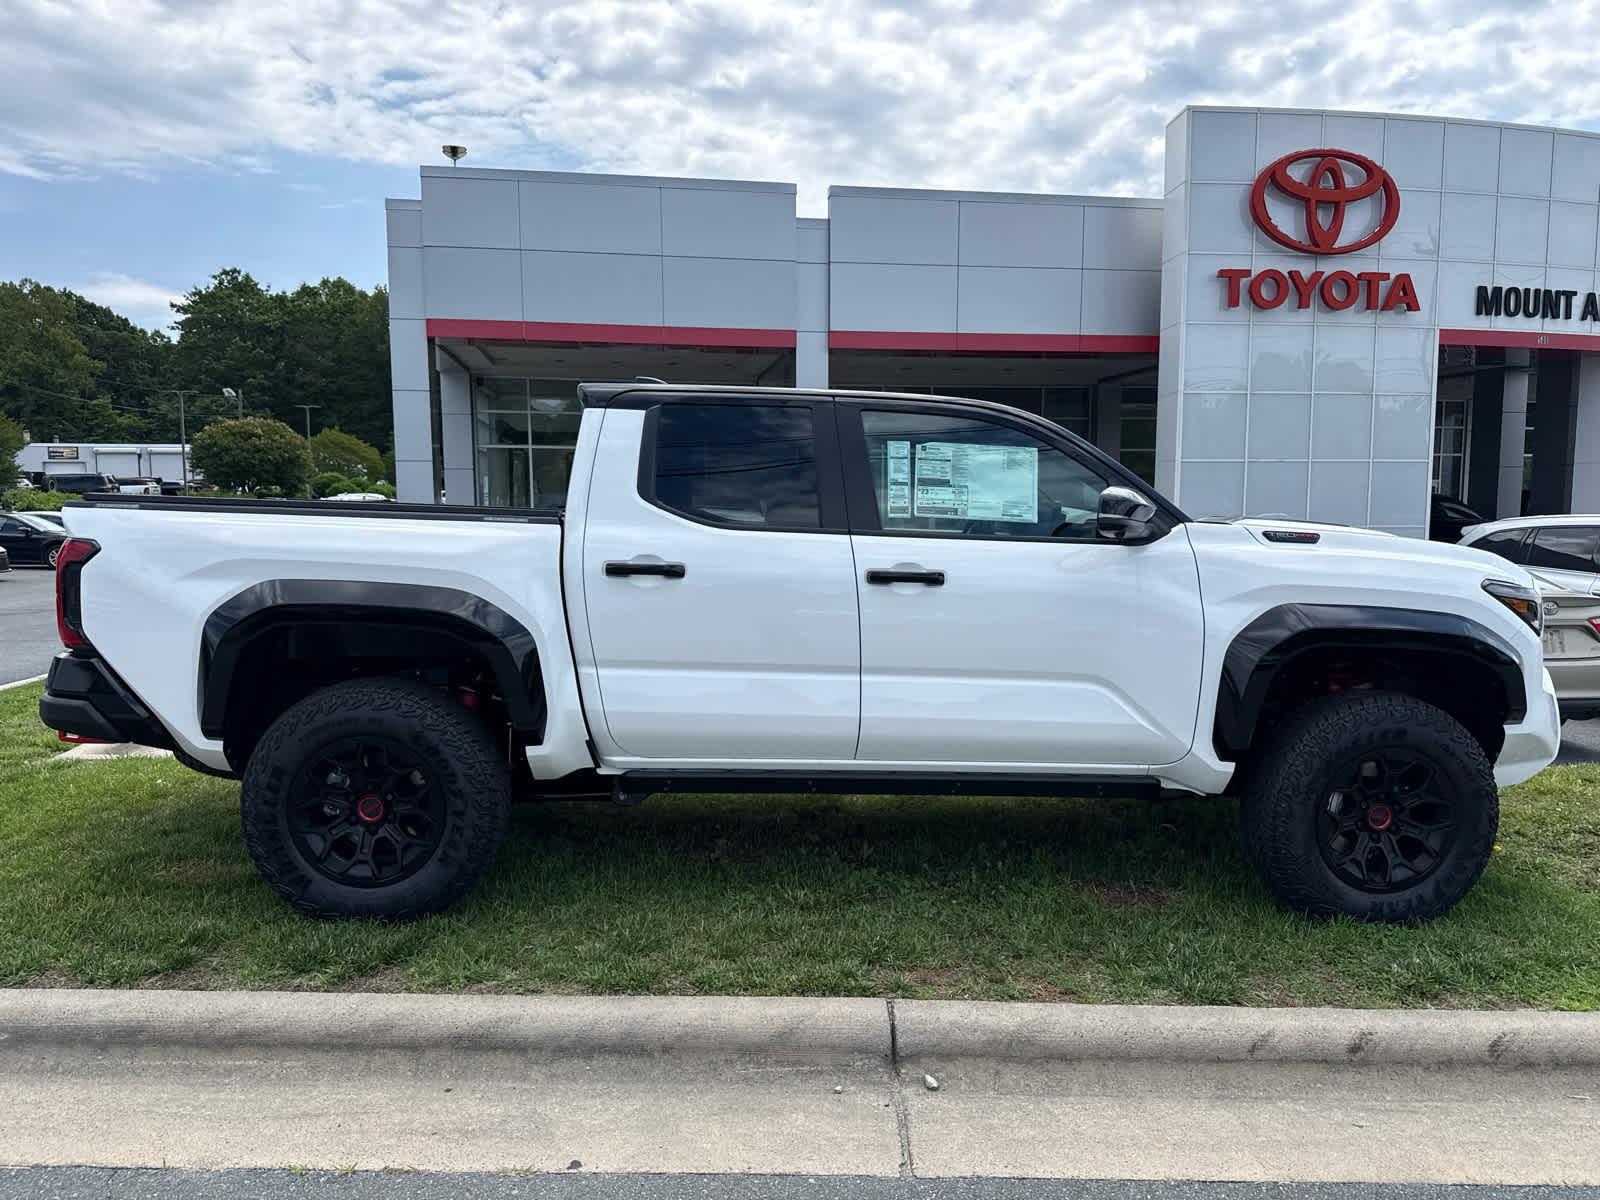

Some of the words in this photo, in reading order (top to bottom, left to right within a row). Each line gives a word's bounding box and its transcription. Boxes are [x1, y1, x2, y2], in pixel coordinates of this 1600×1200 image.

[1217, 268, 1421, 312] TOYOTA
[1475, 286, 1577, 320] MOUNT
[1580, 292, 1600, 322] A
